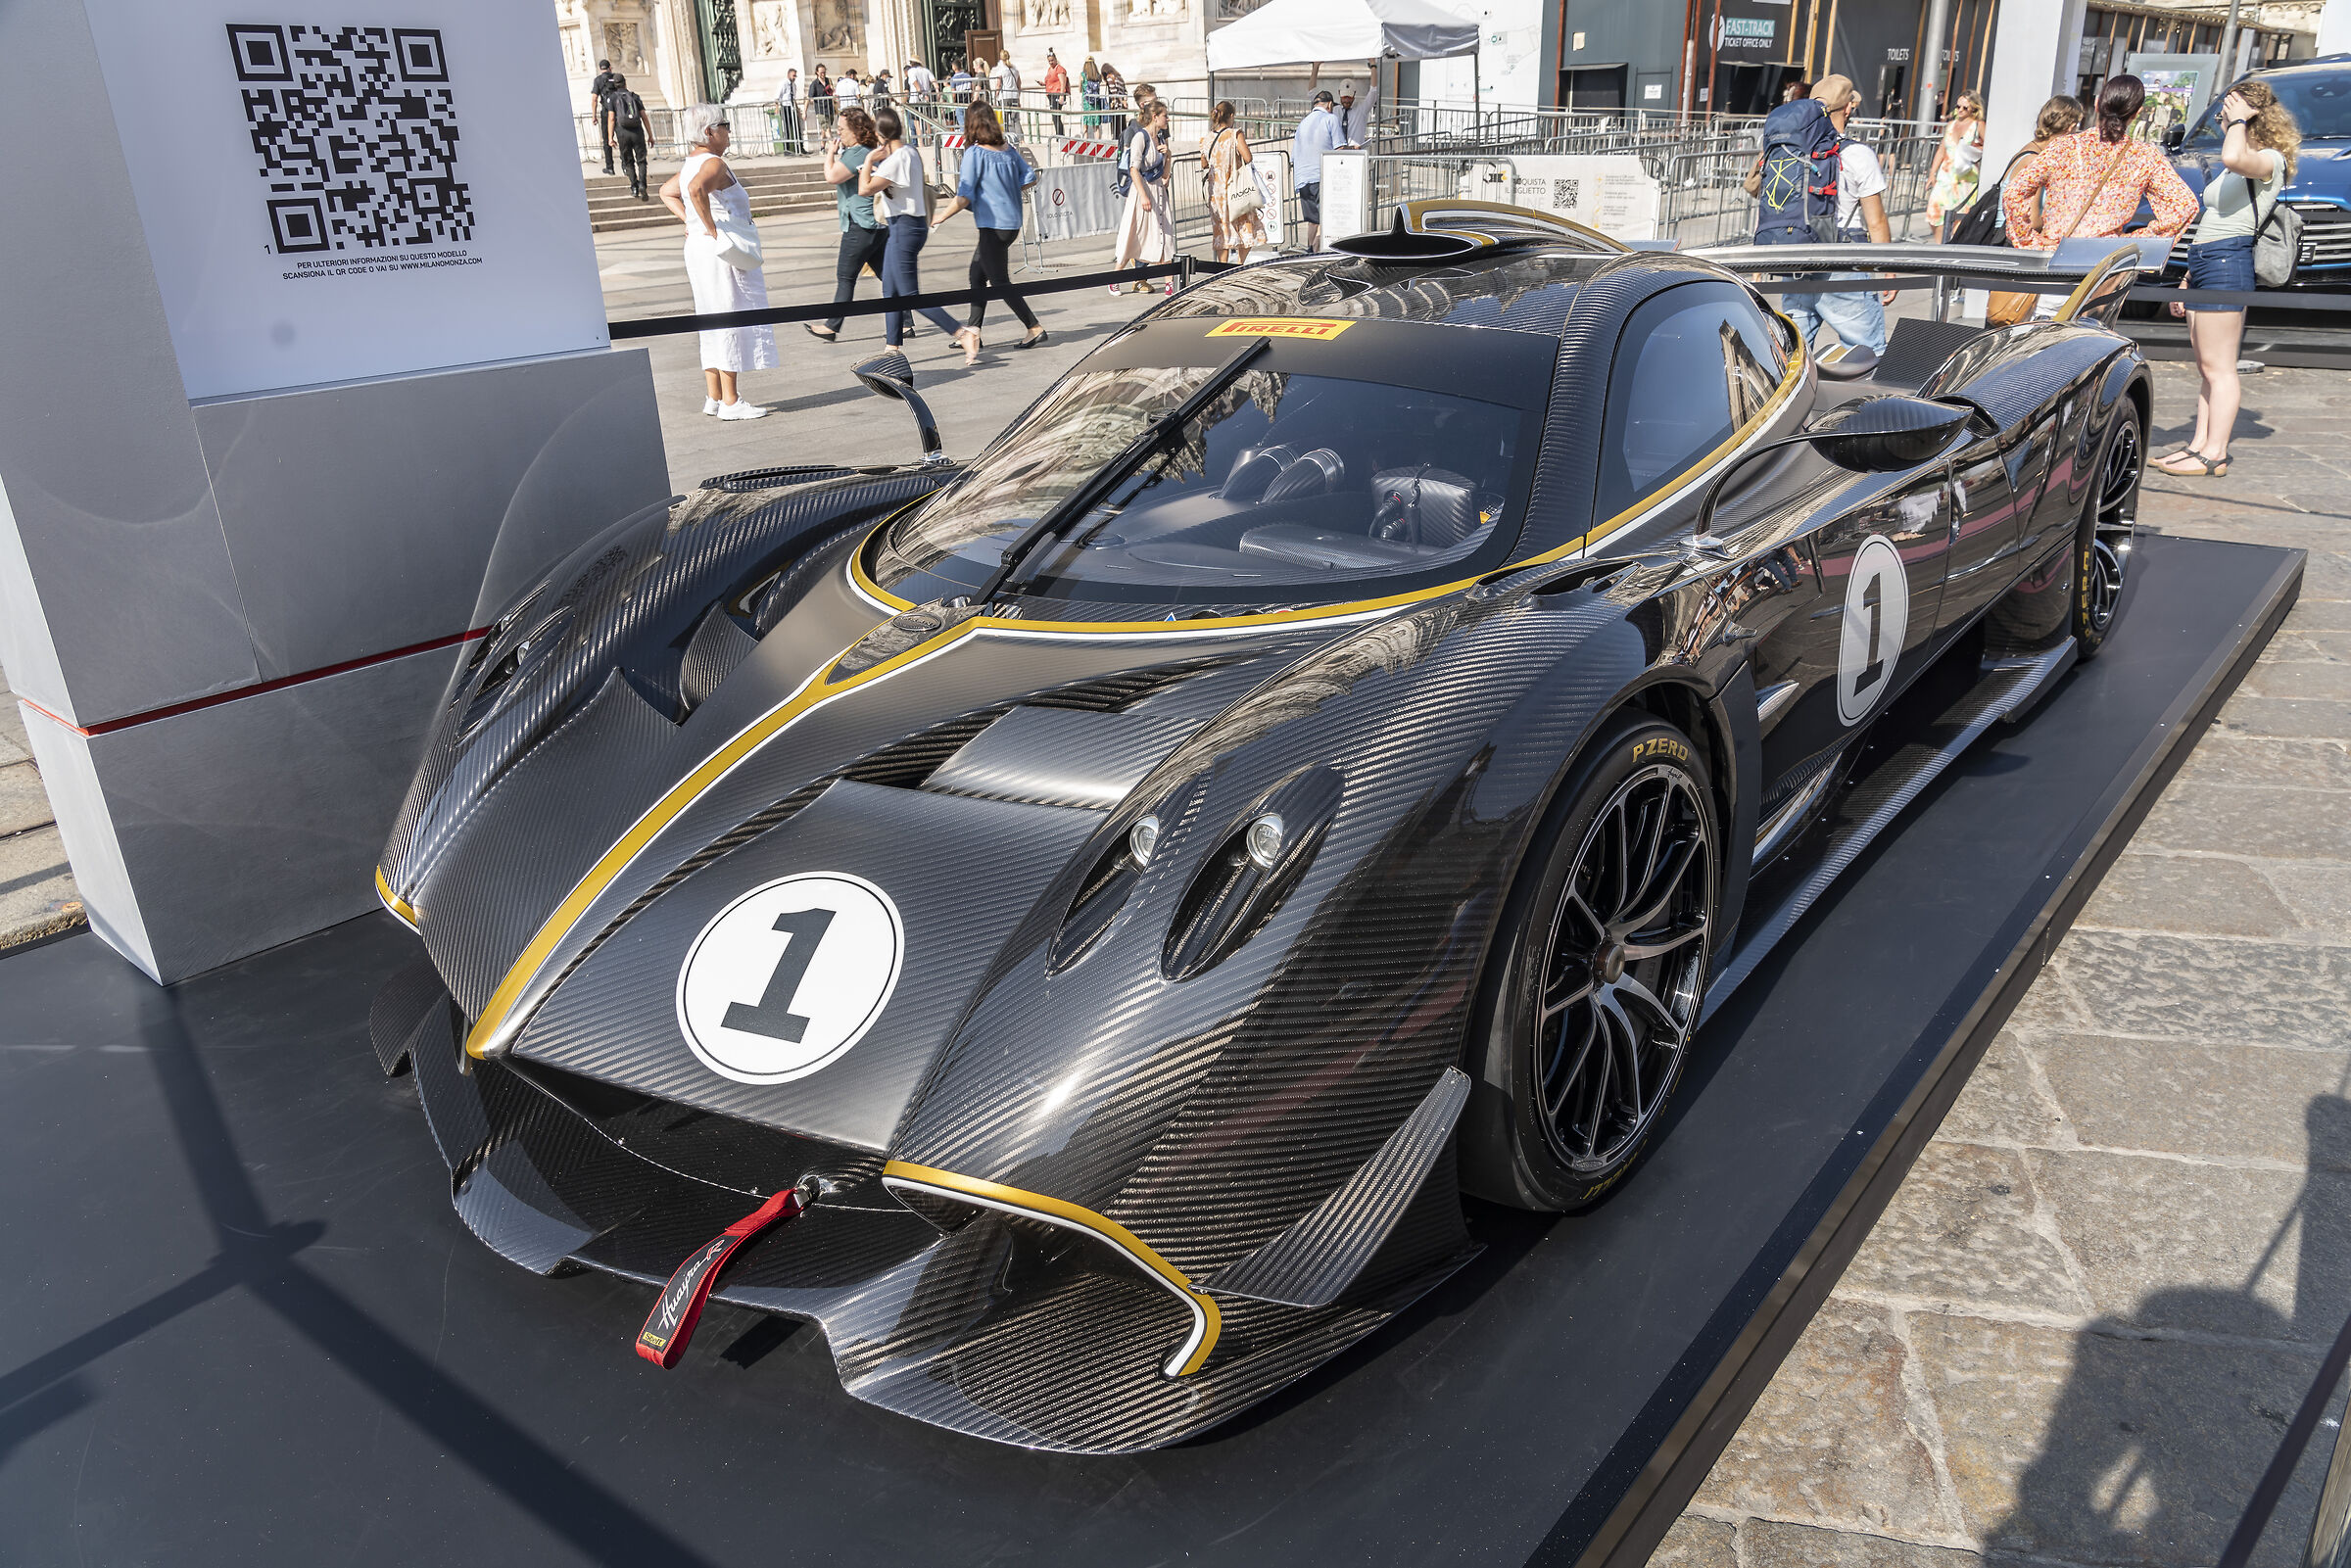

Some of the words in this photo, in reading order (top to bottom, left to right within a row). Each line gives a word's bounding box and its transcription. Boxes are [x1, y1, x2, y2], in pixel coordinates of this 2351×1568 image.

[1726, 20, 1775, 37] FAST-TRACK
[1725, 37, 1742, 47] TICKET
[1743, 38, 1759, 48] OFFICE
[1759, 39, 1773, 48] ONLY
[1888, 48, 1909, 61] TOILETS
[313, 259, 349, 268] ULTERIORI
[350, 255, 399, 265] INFORMAZIONI
[410, 252, 436, 261] QUESTO
[437, 250, 467, 259] MODELLO
[282, 269, 326, 280] SCANSIONA
[348, 266, 367, 275] CODE
[400, 258, 483, 270] WWW.MILANOMONZA.COM
[1222, 321, 1337, 336] PIRELLI
[1853, 572, 1884, 697] 1
[721, 908, 837, 1044] 1
